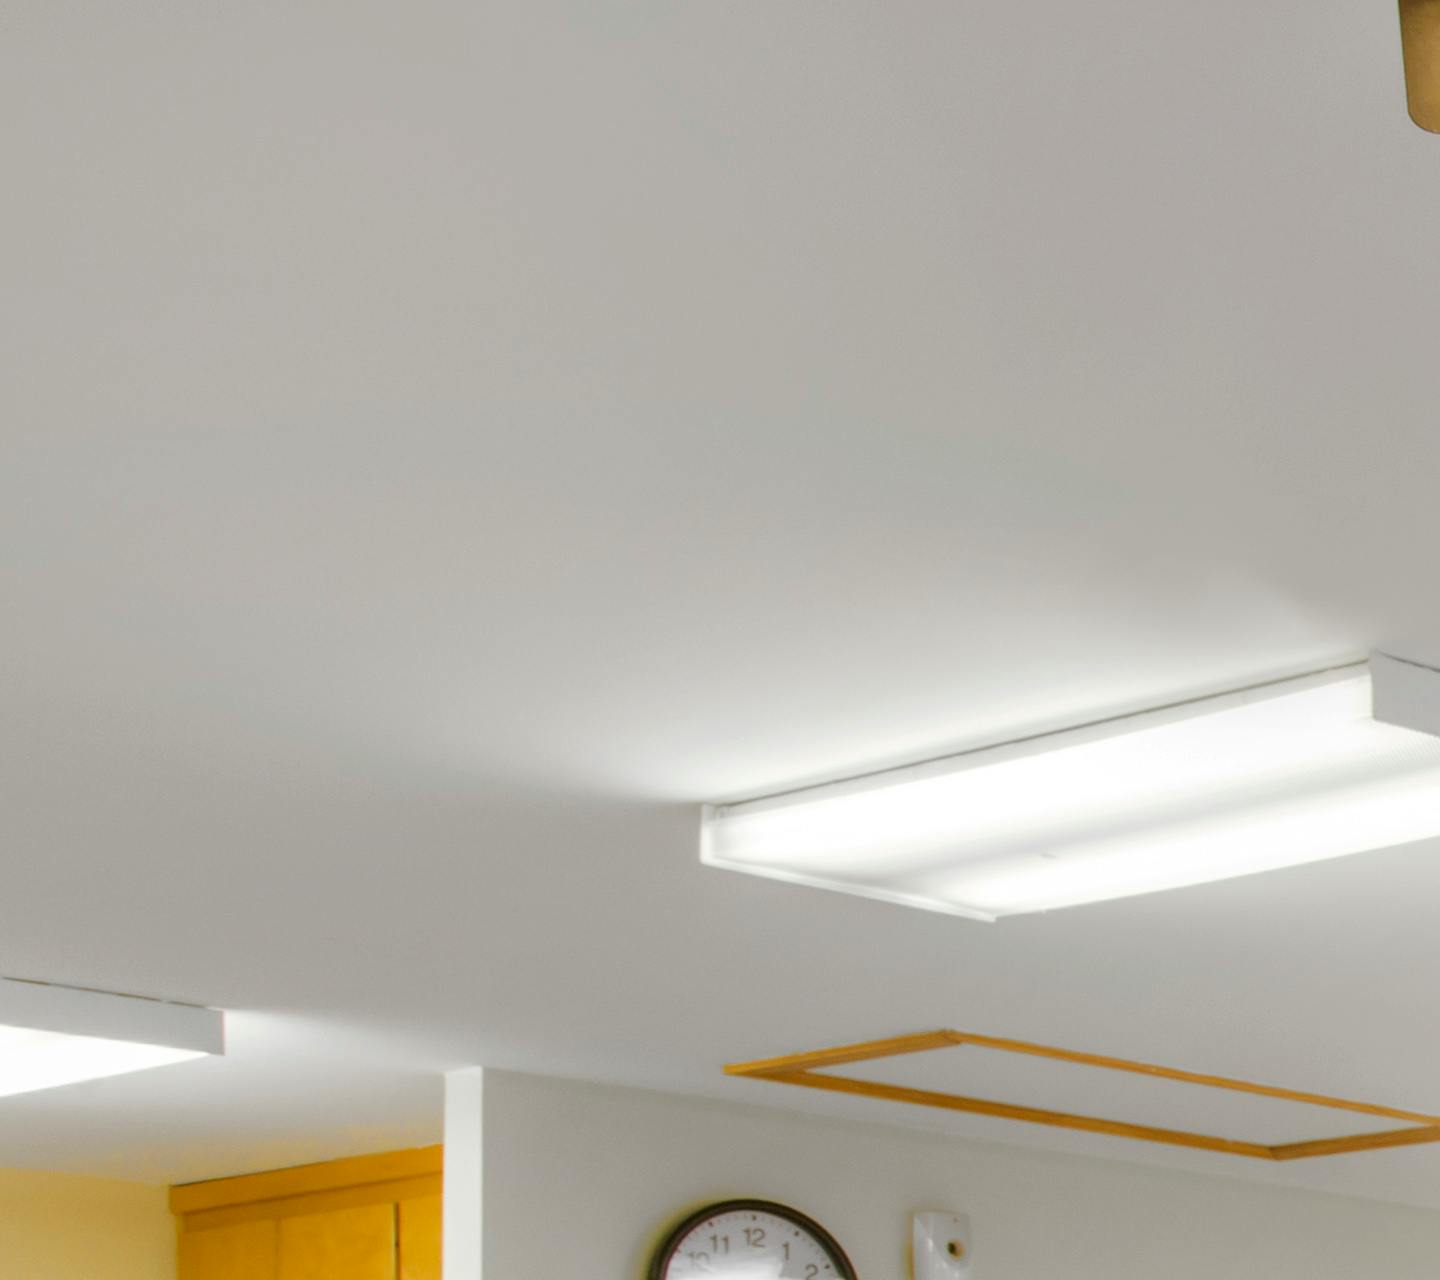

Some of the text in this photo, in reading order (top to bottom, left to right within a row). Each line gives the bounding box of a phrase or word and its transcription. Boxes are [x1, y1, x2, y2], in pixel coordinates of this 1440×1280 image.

[710, 1235, 731, 1254] 11
[743, 1227, 766, 1248] 12
[782, 1243, 790, 1261] 1
